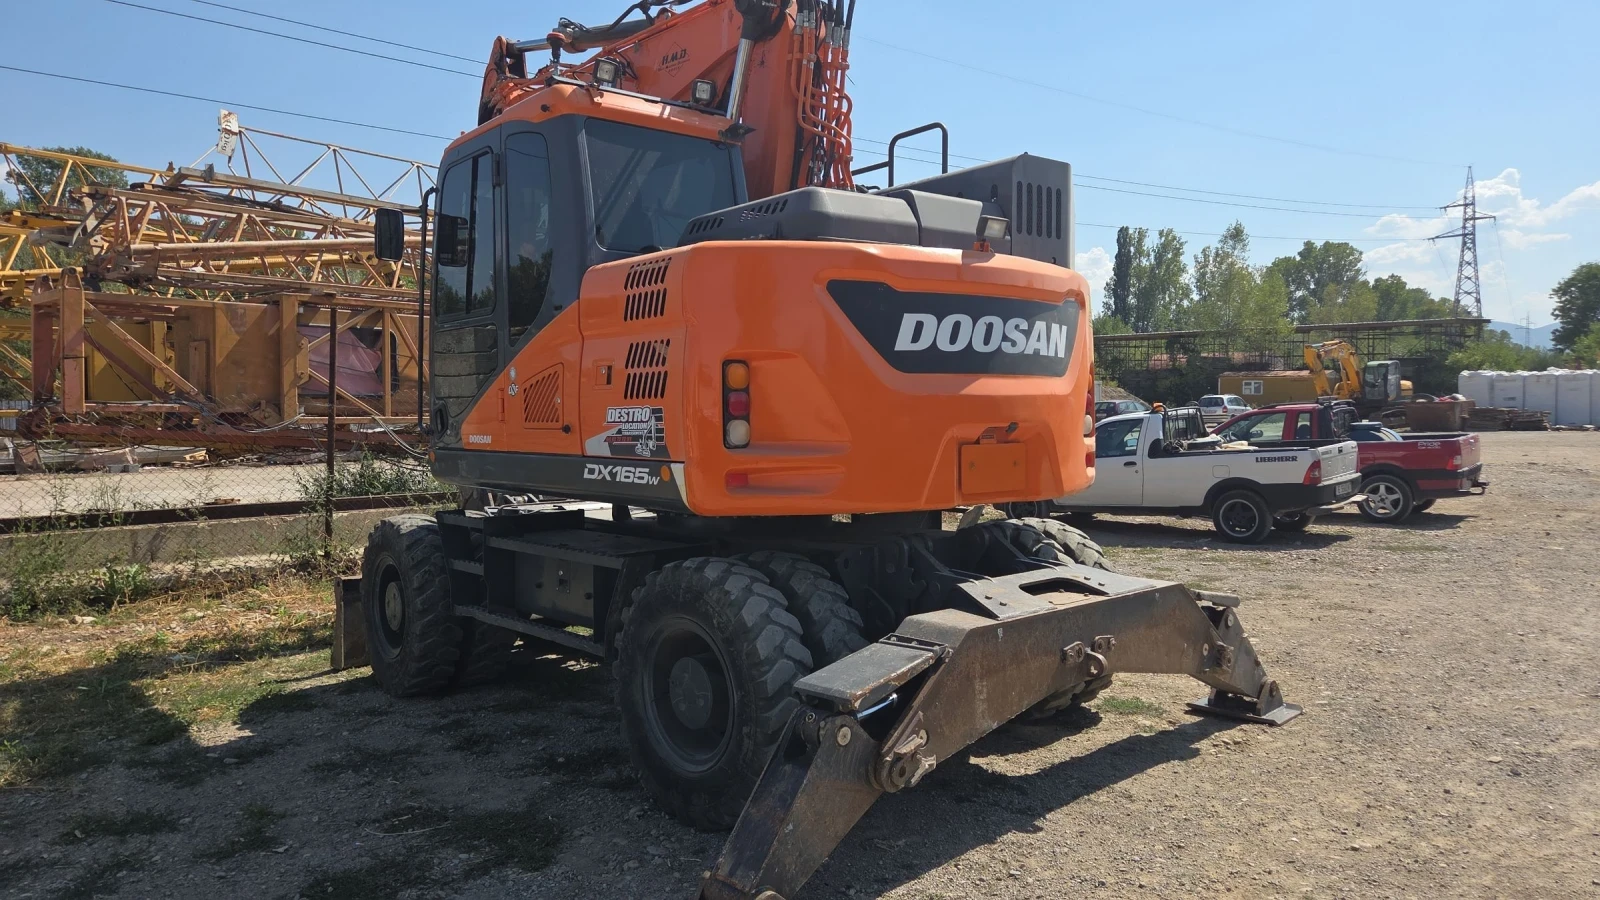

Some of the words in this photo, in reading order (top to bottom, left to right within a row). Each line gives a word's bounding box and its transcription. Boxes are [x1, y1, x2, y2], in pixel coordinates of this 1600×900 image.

[894, 312, 1067, 358] DOOSAN
[607, 406, 650, 422] DESTRO
[469, 434, 492, 443] DOOSAN
[1255, 455, 1298, 463] LIEBHERR
